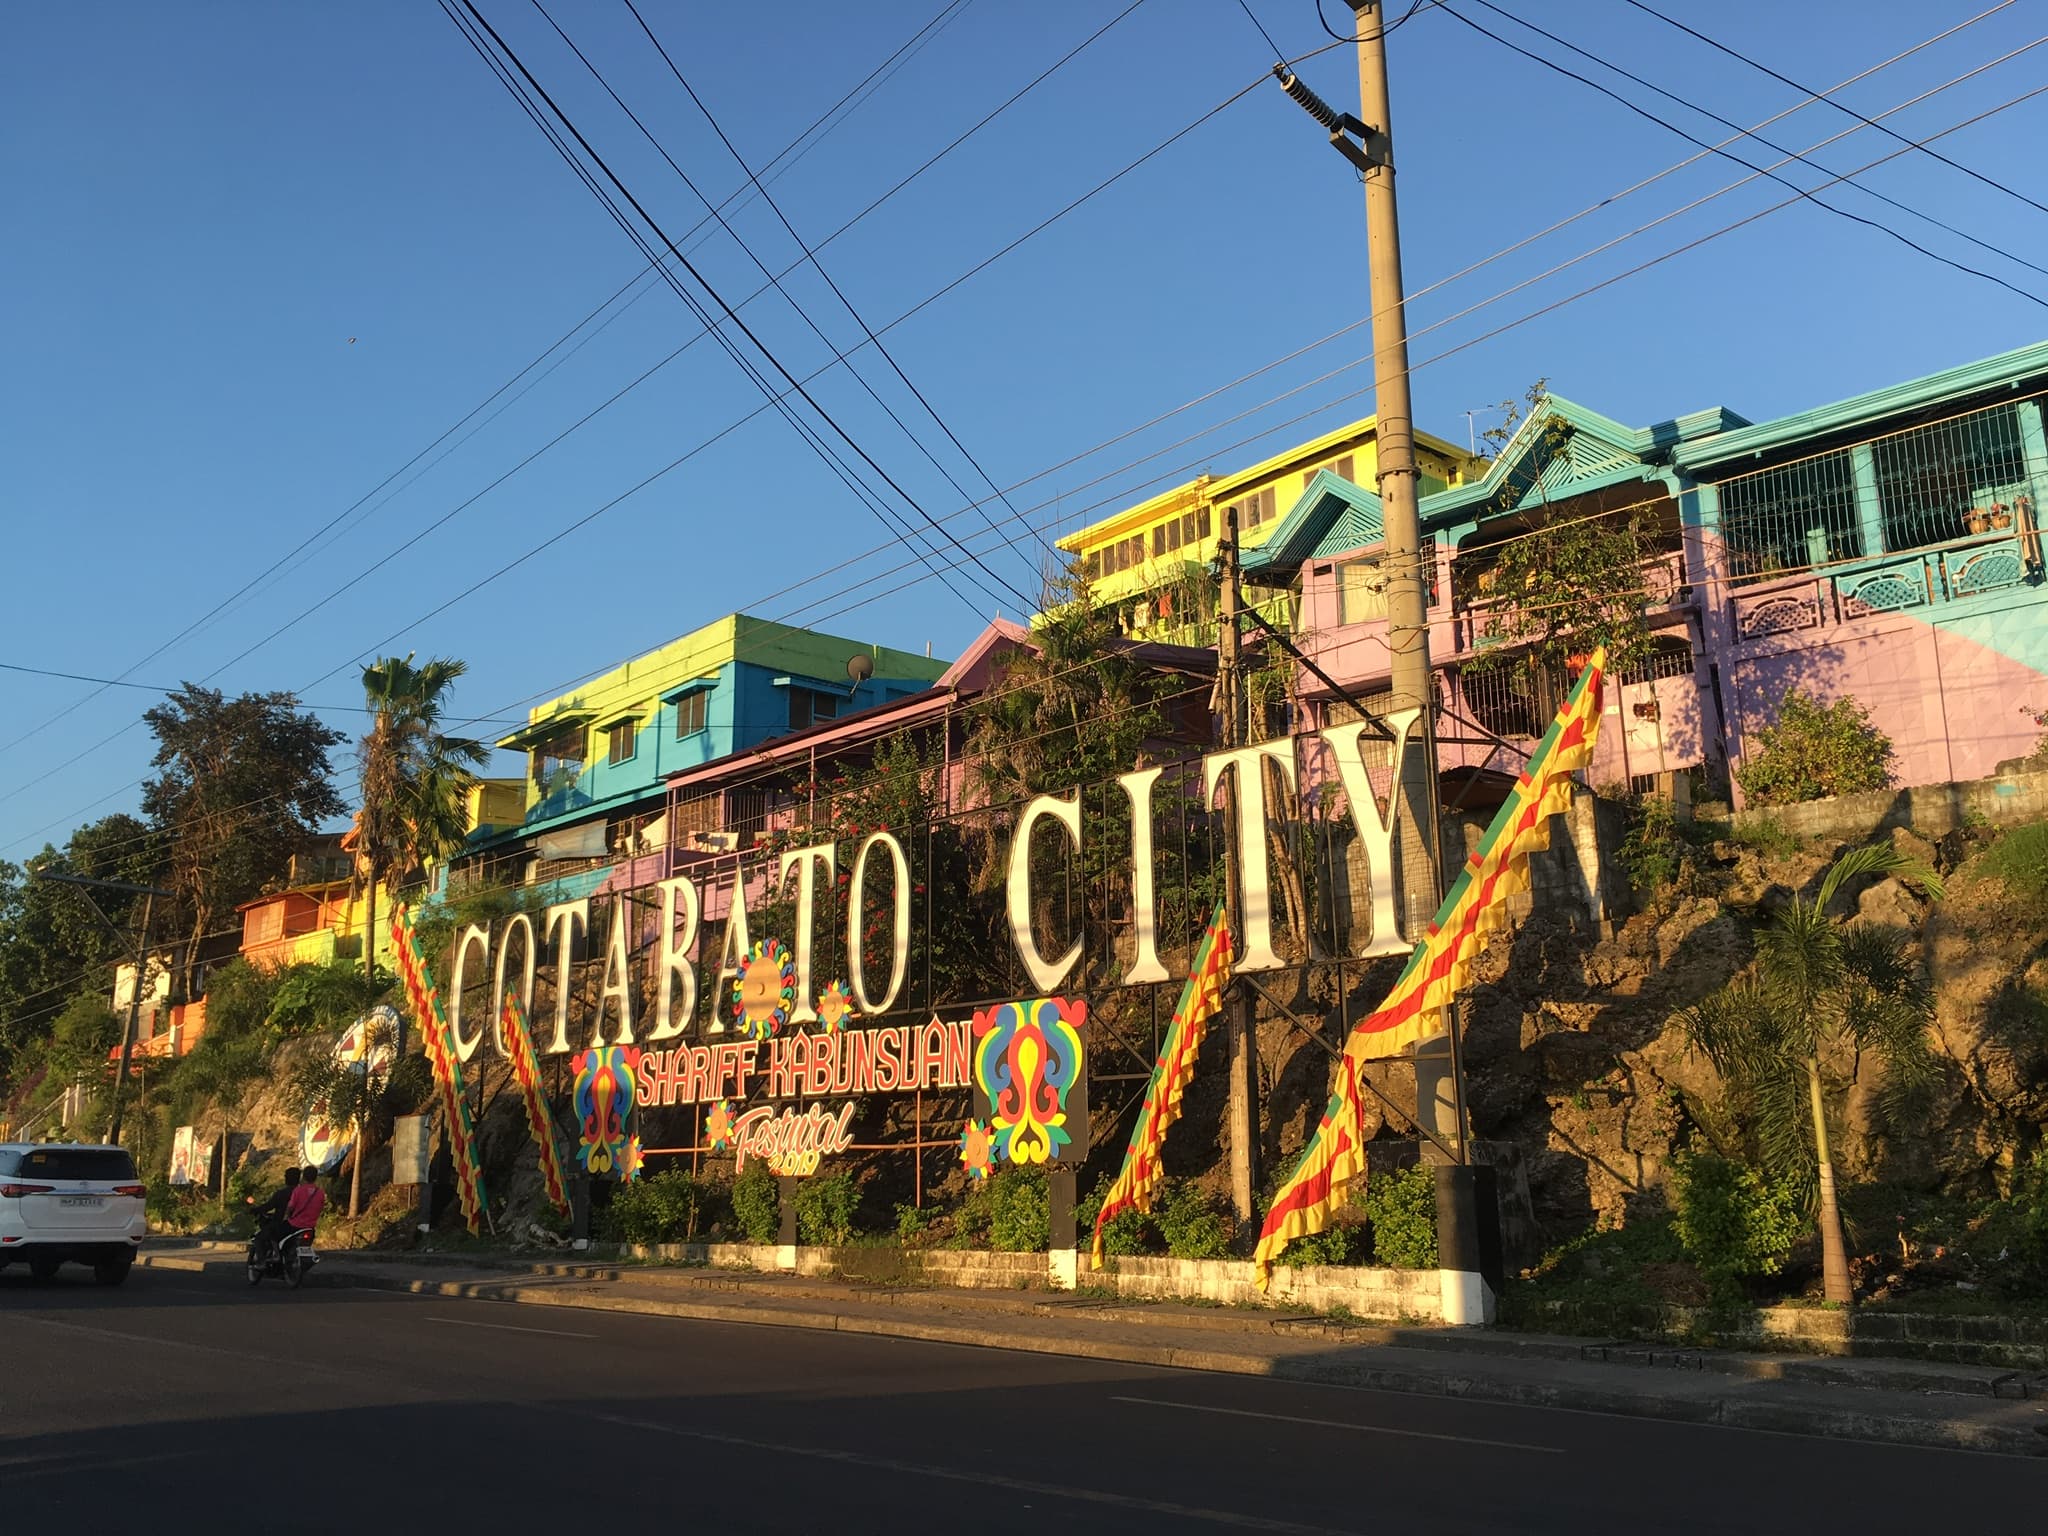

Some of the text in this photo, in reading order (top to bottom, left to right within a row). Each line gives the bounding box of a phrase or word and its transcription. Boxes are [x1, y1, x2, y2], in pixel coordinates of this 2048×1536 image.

[450, 705, 1423, 1063] COTABATO CITY
[636, 1013, 975, 1107] SHARIFF KABUNSUAN
[732, 1101, 856, 1175] Festival
[767, 1149, 820, 1176] 2019
